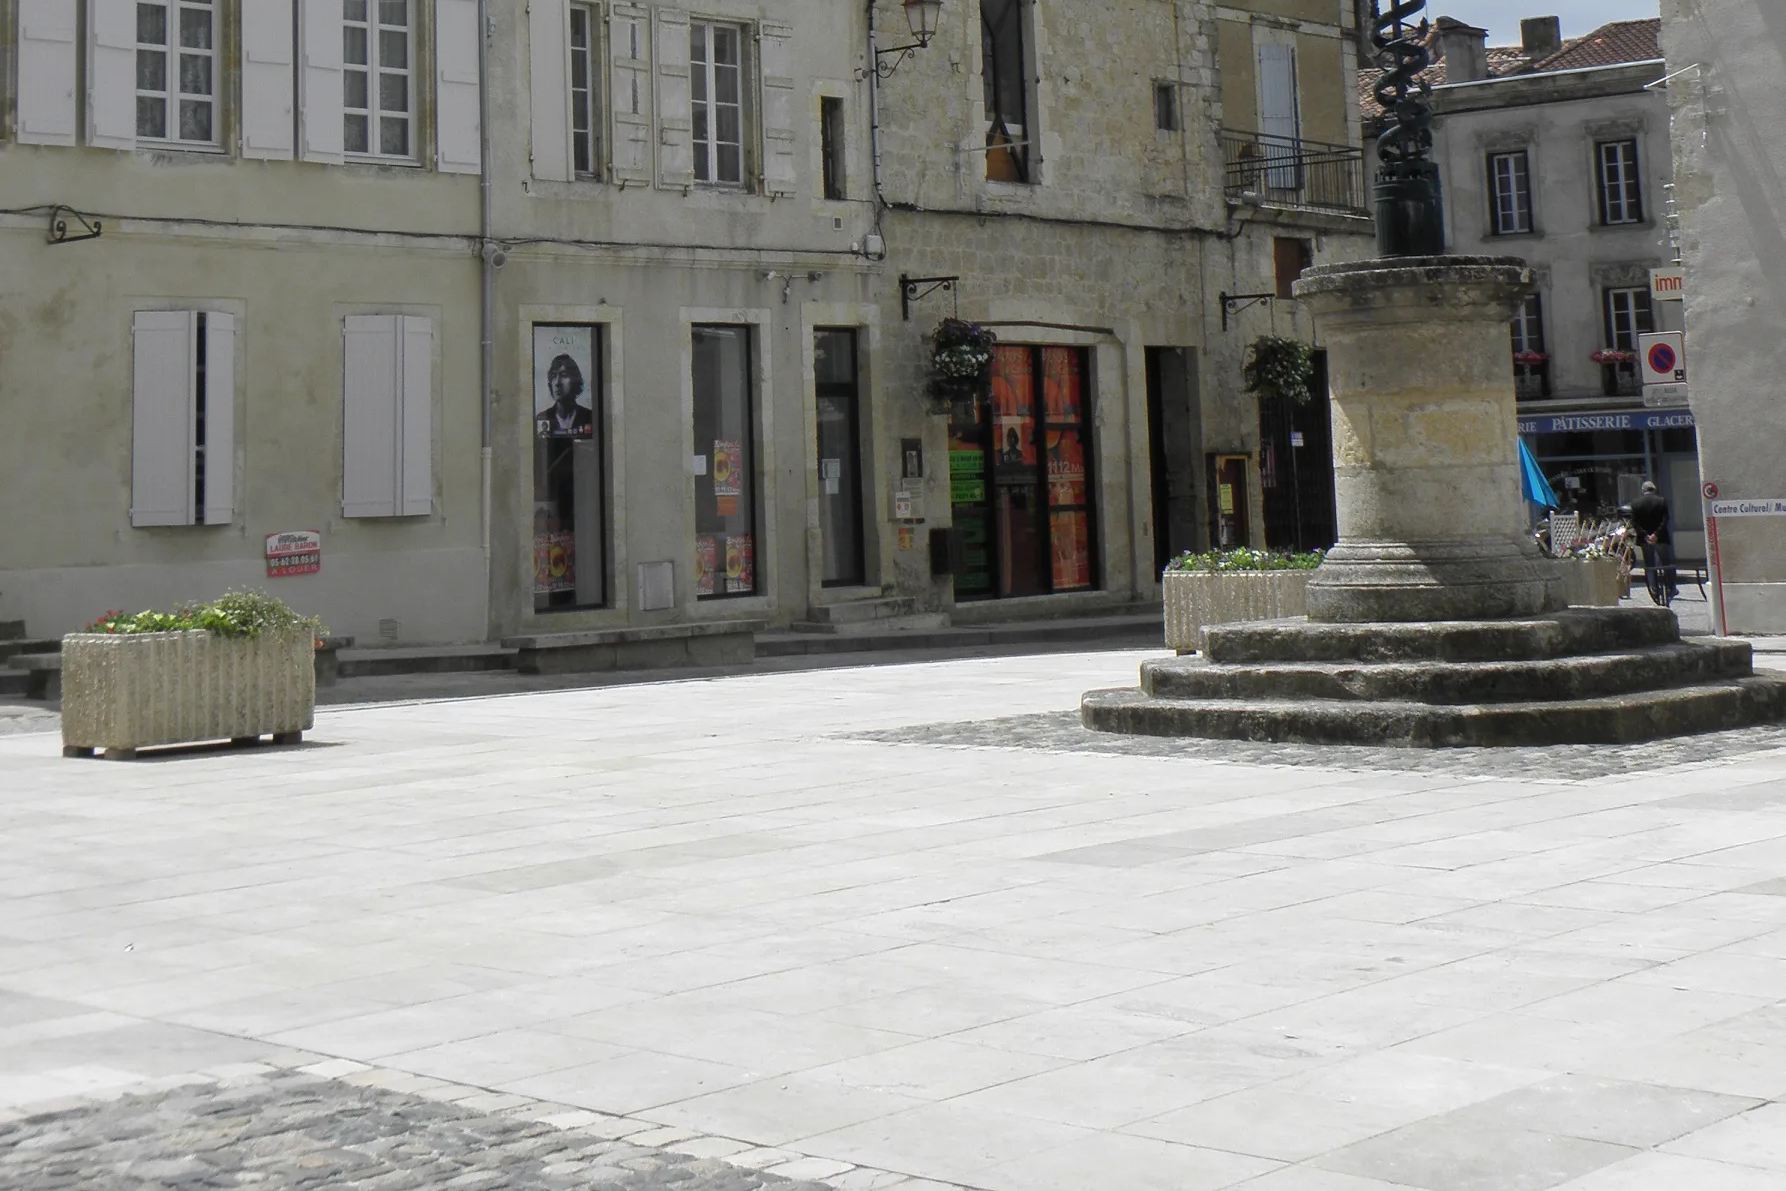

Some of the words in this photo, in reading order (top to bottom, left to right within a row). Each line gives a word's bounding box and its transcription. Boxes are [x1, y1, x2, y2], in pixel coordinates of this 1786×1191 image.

[552, 336, 574, 345] CALI
[1552, 415, 1631, 431] PÂTISSERIE
[1713, 504, 1738, 514] Centre
[282, 564, 318, 574] LOUER
